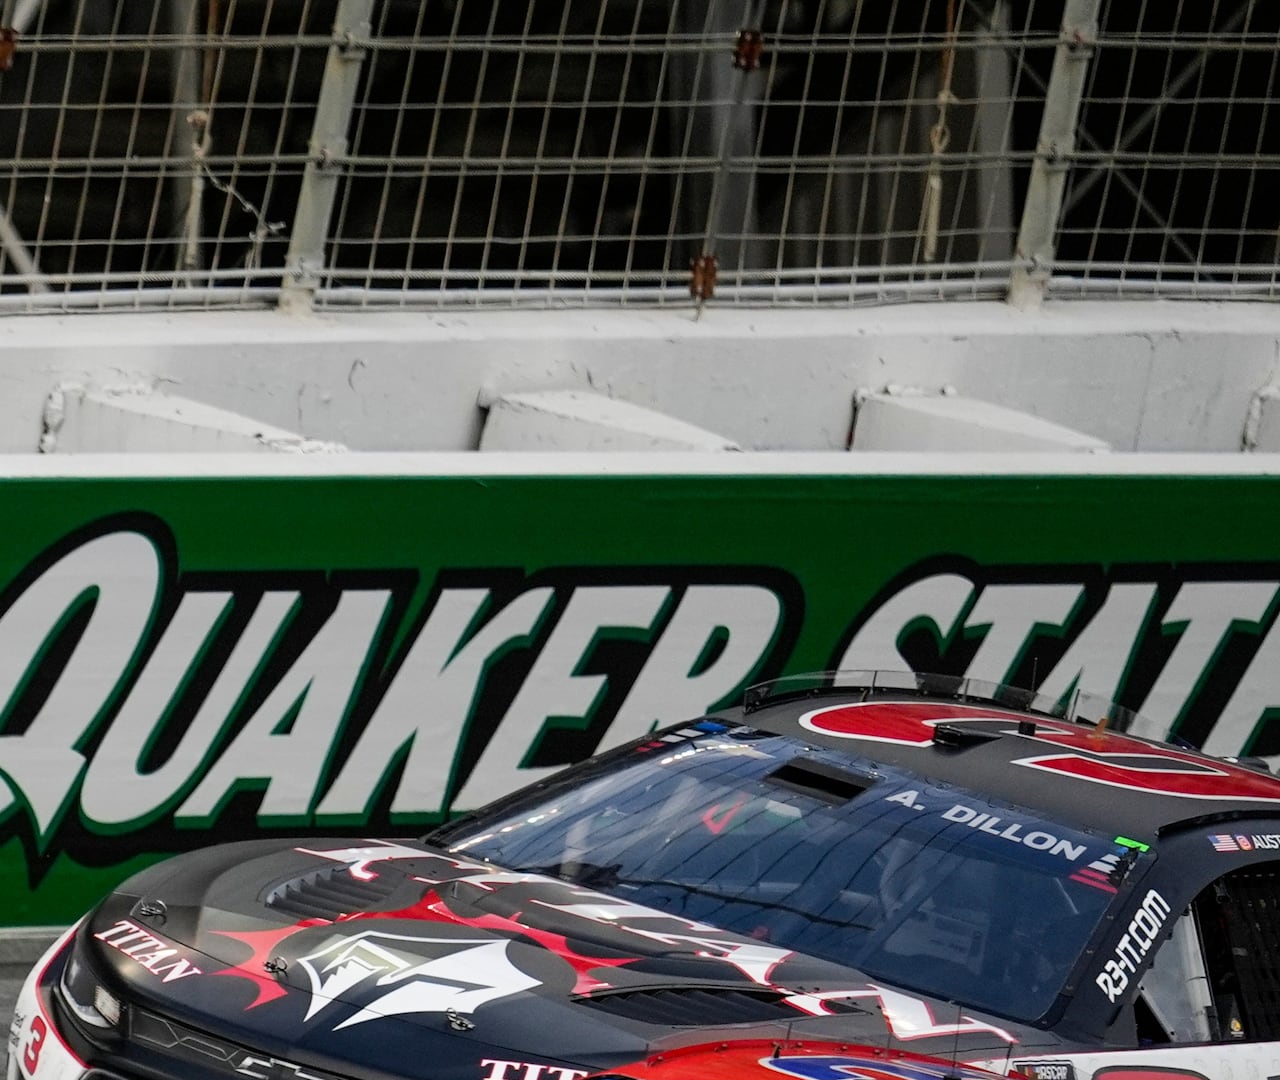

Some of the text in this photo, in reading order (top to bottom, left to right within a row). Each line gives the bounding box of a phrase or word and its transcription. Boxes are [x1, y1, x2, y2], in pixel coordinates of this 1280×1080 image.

[885, 787, 1088, 863] A. DILLON
[93, 919, 202, 983] TITAN
[23, 1015, 47, 1076] 3
